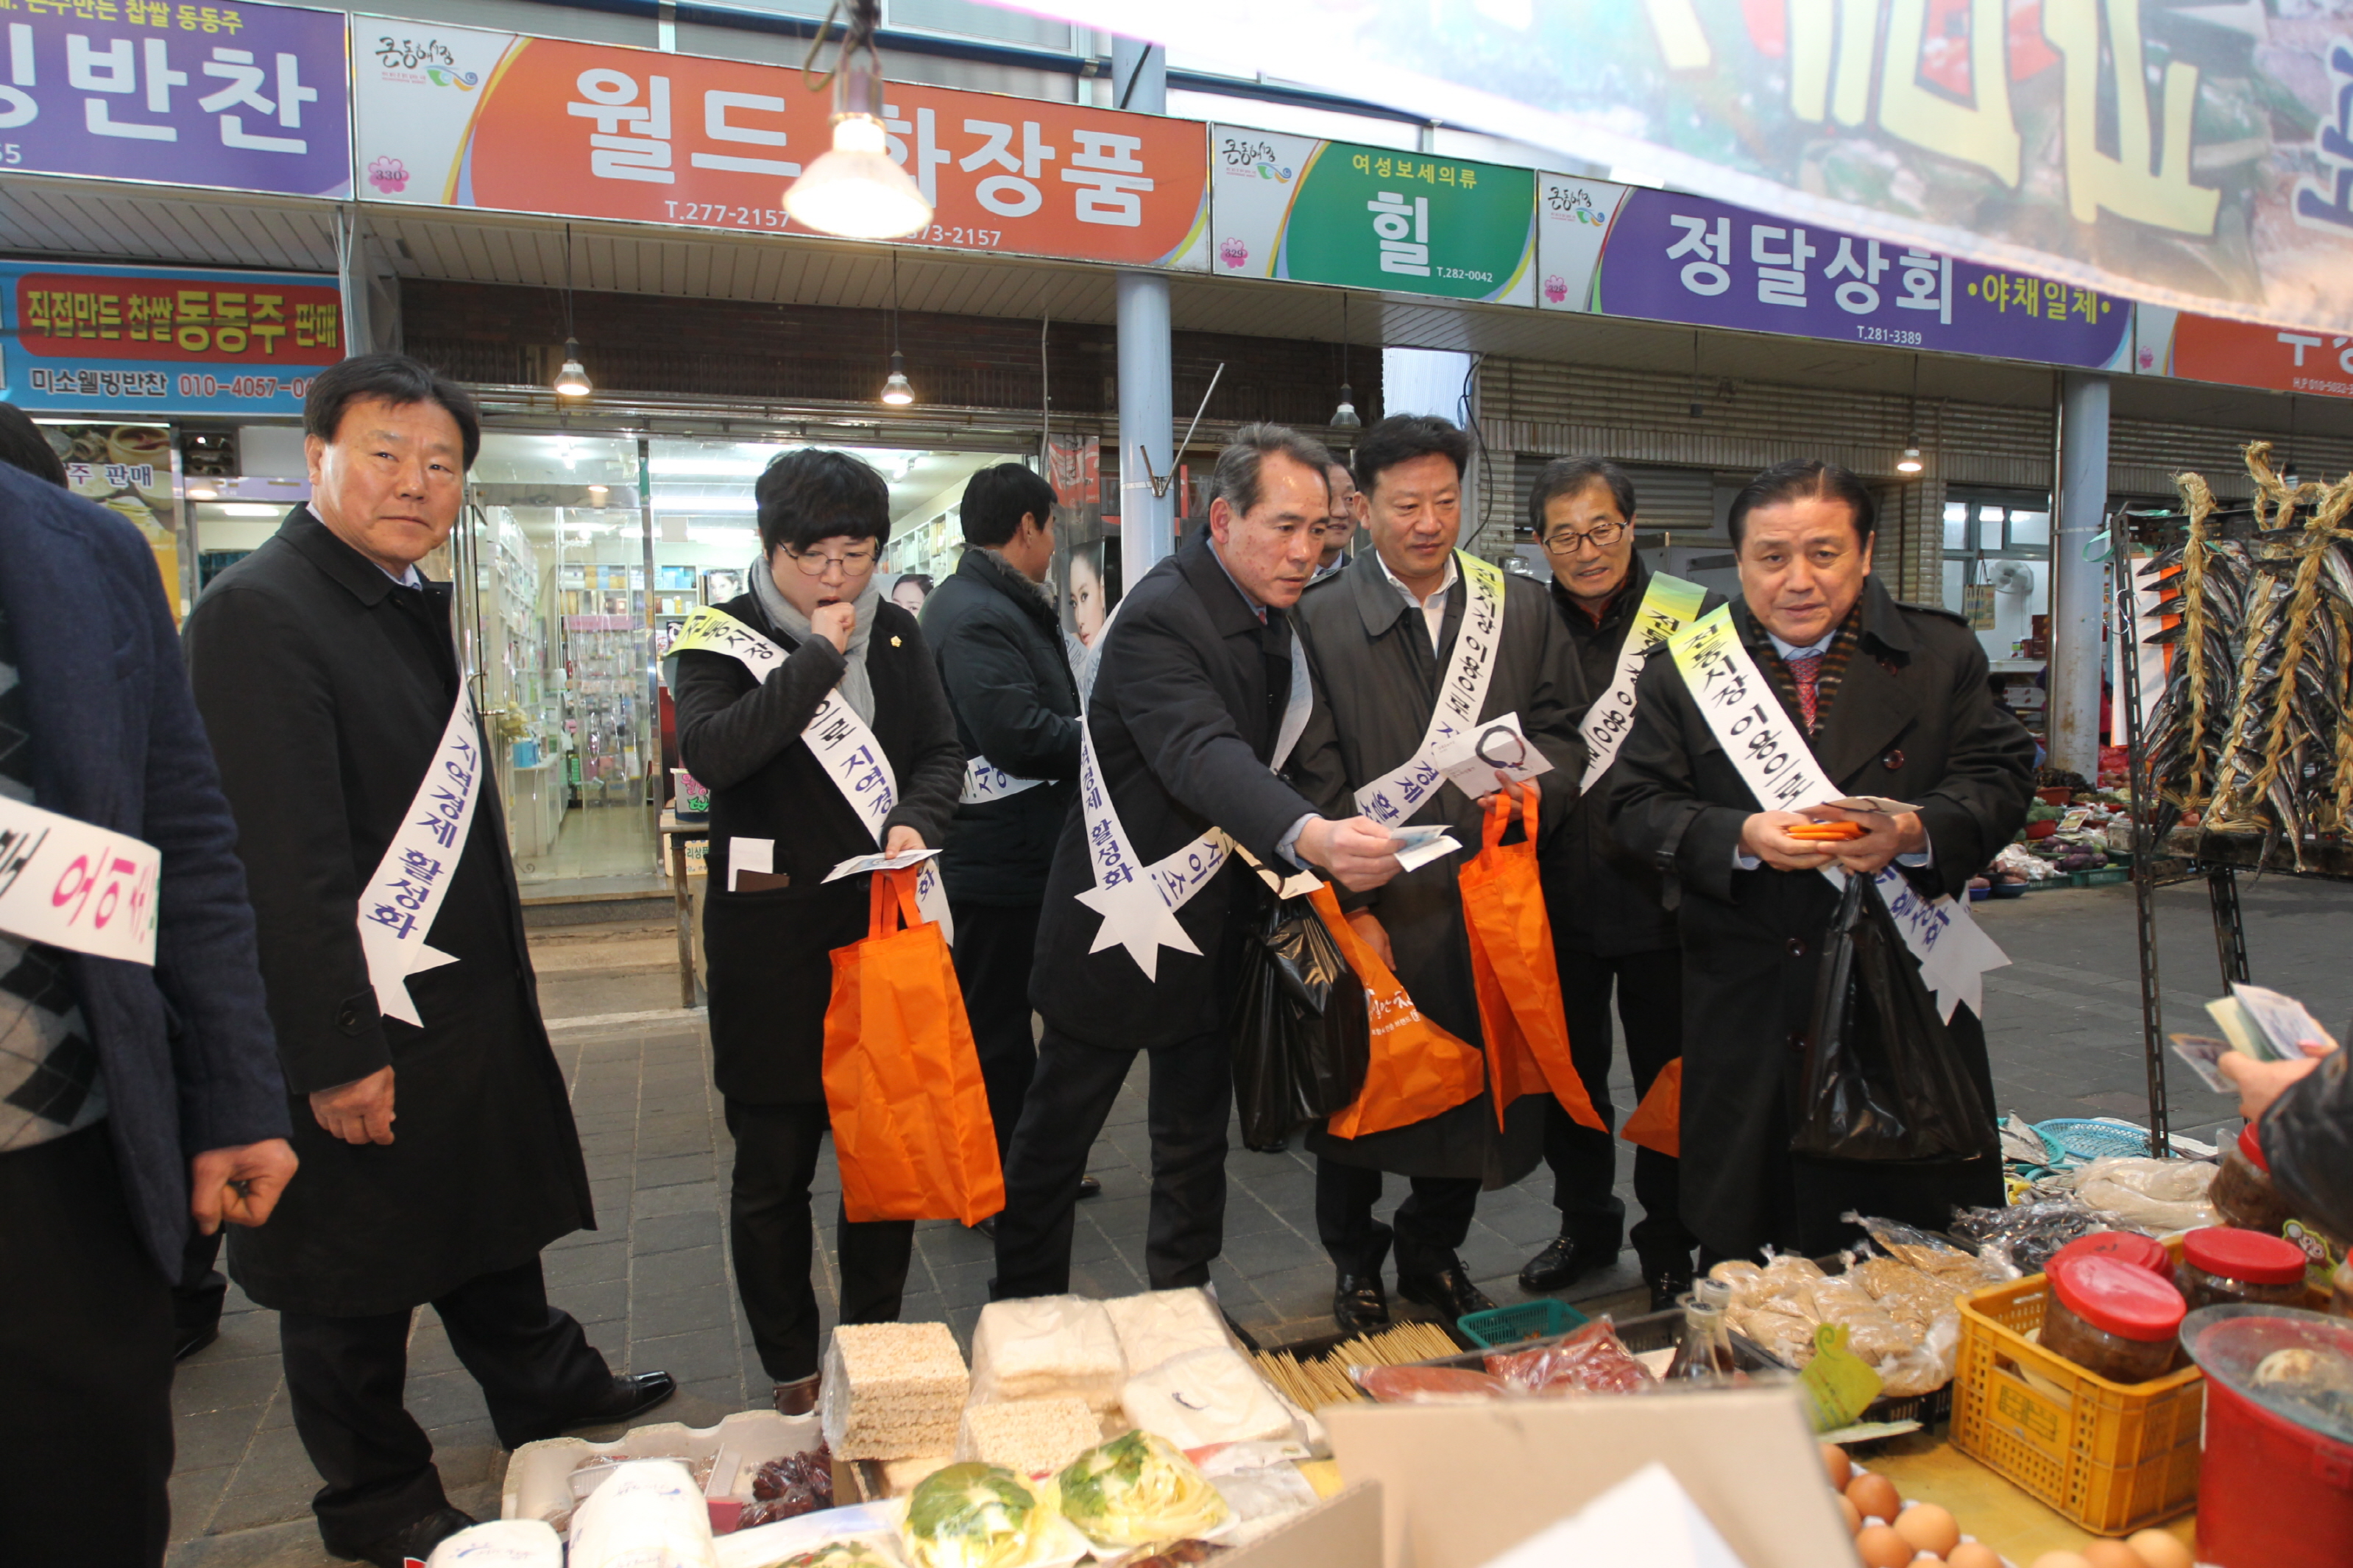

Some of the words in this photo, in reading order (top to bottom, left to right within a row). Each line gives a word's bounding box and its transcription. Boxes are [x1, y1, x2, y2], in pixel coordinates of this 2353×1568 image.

[124, 1, 171, 28] 찹쌀
[177, 4, 244, 35] 동동주
[566, 68, 802, 184] 월드
[882, 103, 1154, 227] 화장품
[1352, 153, 1477, 190] 여성보세의류
[375, 170, 403, 181] 330
[665, 200, 790, 228] T.277-2157
[1367, 191, 1431, 277] 힐
[1225, 249, 1244, 259] 329
[1436, 266, 1493, 283] T.282-0042
[1666, 213, 1953, 324] 정달상회
[27, 291, 122, 339] 직접만든
[128, 294, 174, 342] 찹쌀
[176, 291, 286, 355] 동동주
[294, 303, 339, 349] 판매
[1857, 325, 1922, 345] T.281-3389
[32, 369, 168, 397] 미소웰빙반찬
[105, 463, 154, 487] 판매
[1469, 562, 1504, 636] 전통시장
[680, 613, 774, 661] 전통시장
[1684, 622, 1747, 709] 전통시장
[415, 734, 478, 848] 지역경제
[1091, 819, 1134, 891] 활성화
[364, 846, 446, 940] 활성화
